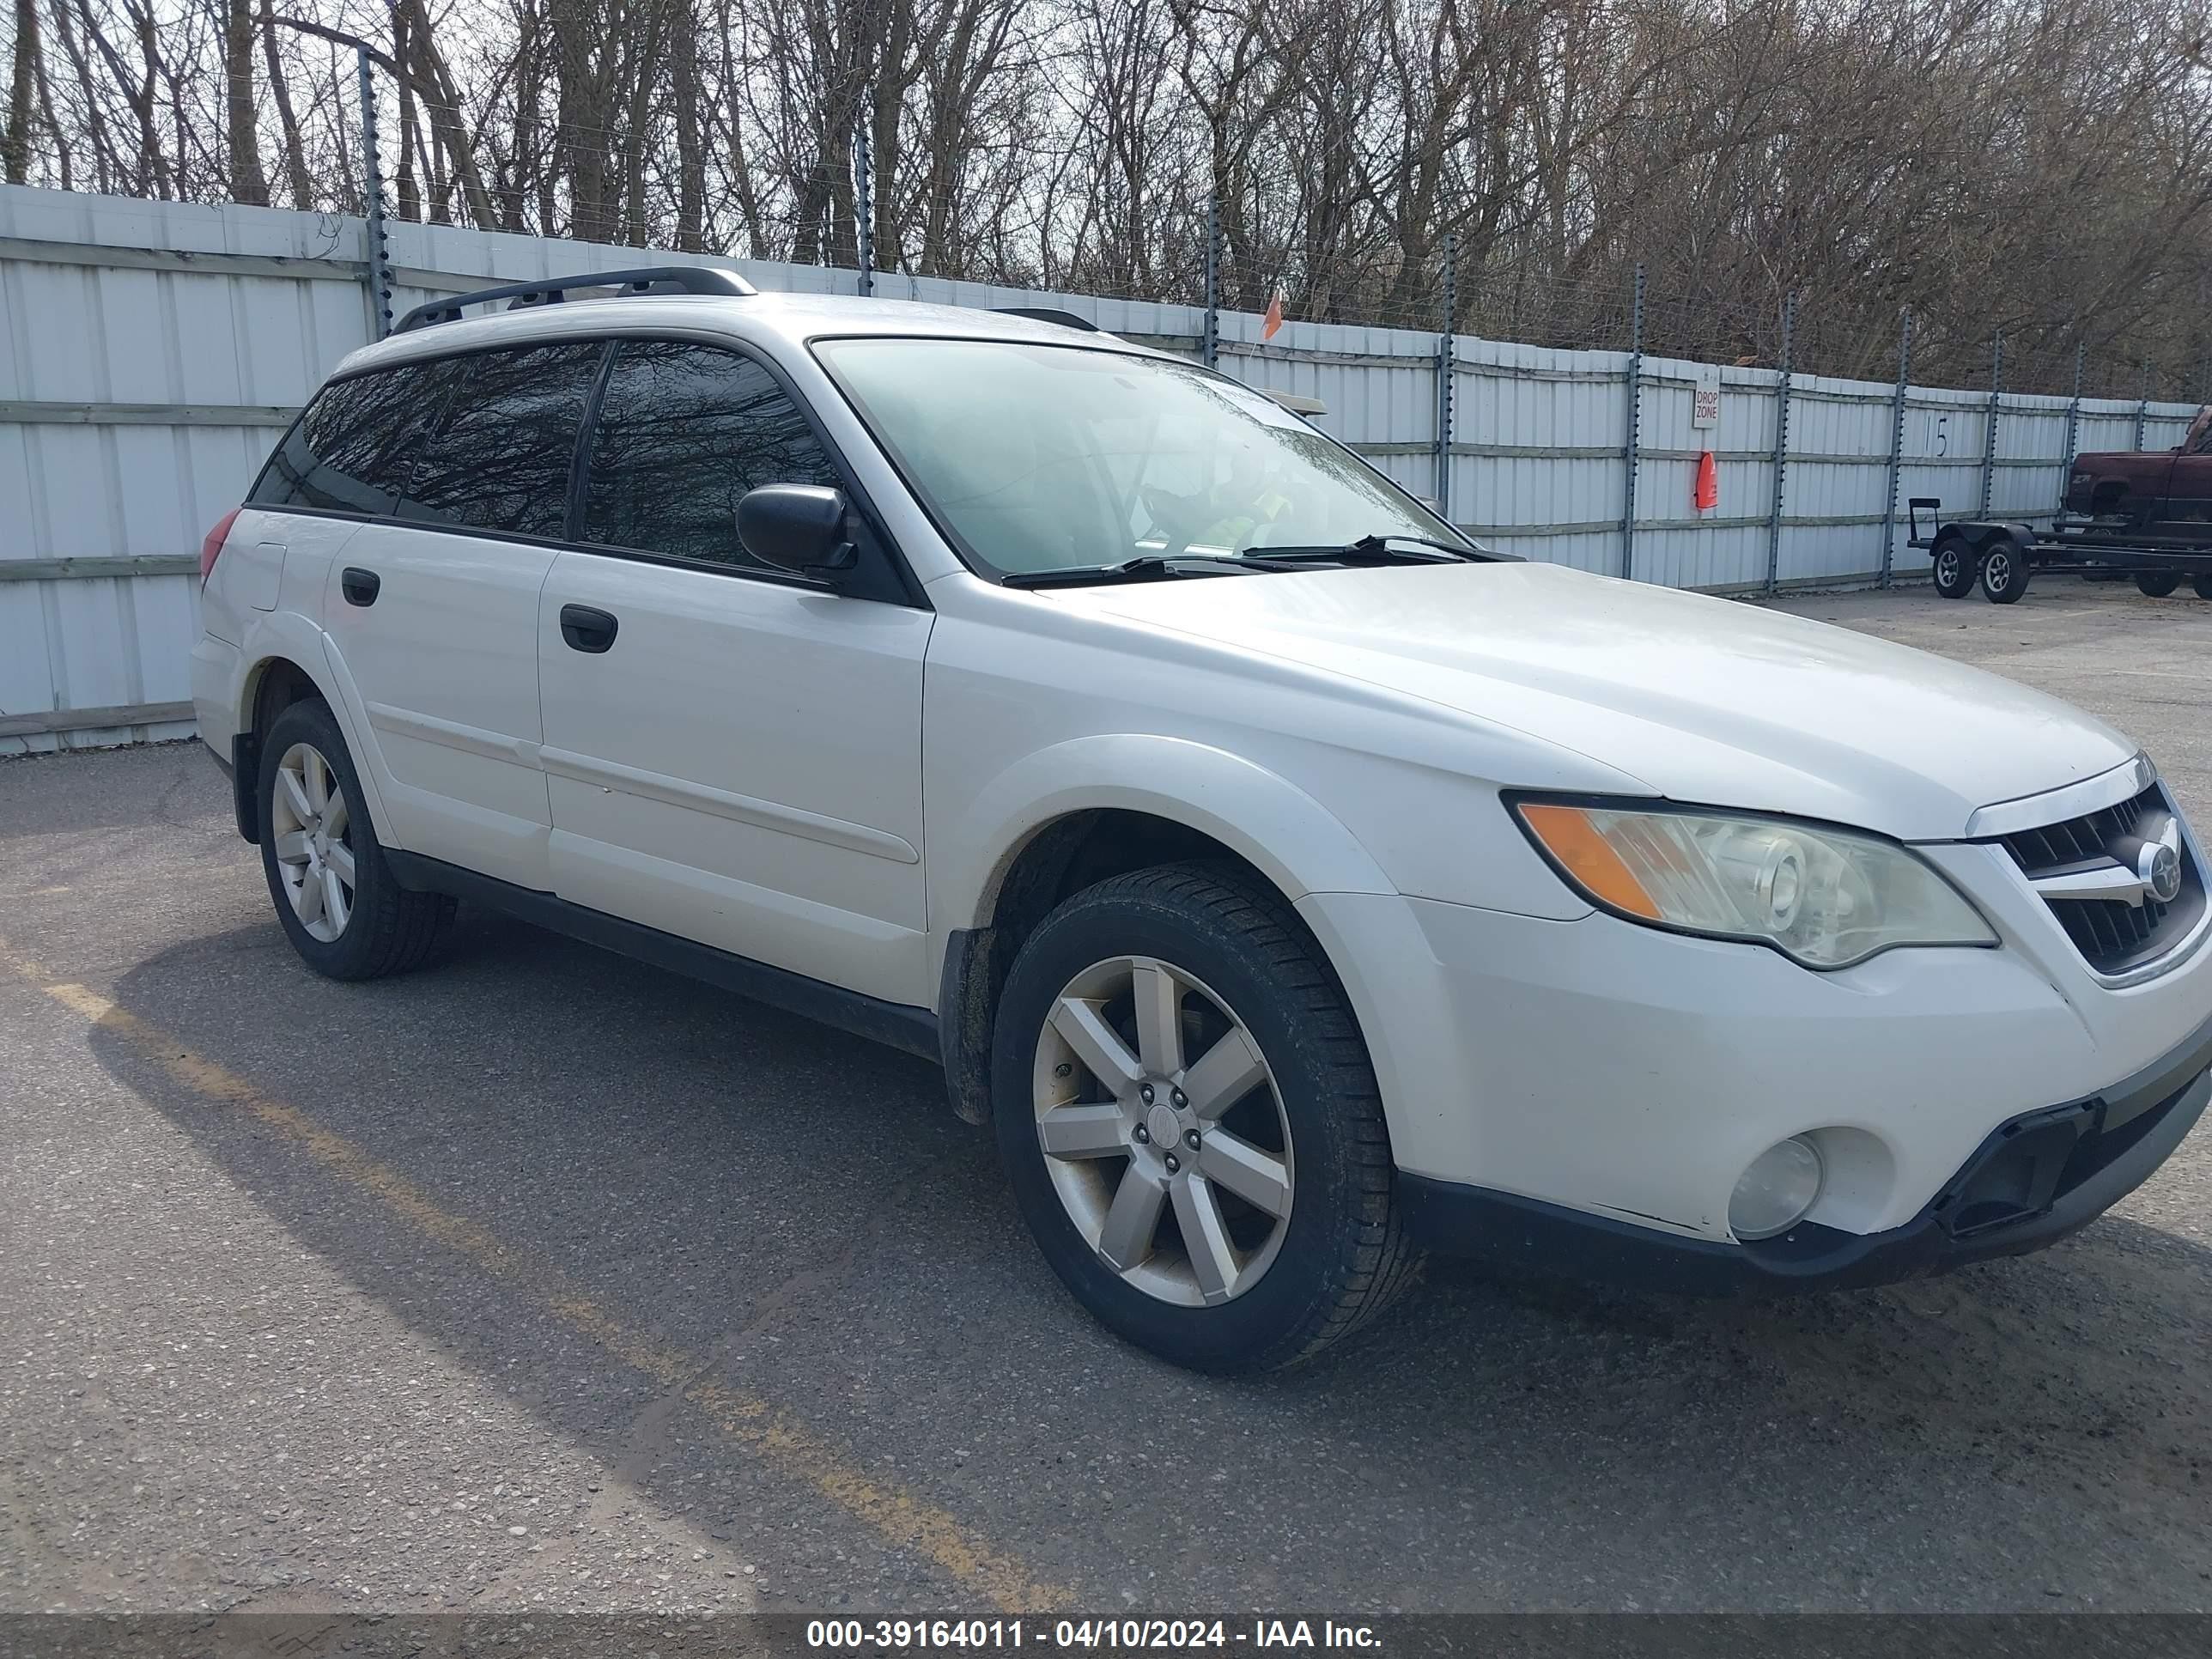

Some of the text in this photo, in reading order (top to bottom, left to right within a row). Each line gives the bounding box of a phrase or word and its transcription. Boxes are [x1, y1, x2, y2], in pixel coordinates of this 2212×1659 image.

[1697, 392, 1718, 404] DROP
[1696, 405, 1717, 419] ZONE
[1926, 416, 1947, 457] 15
